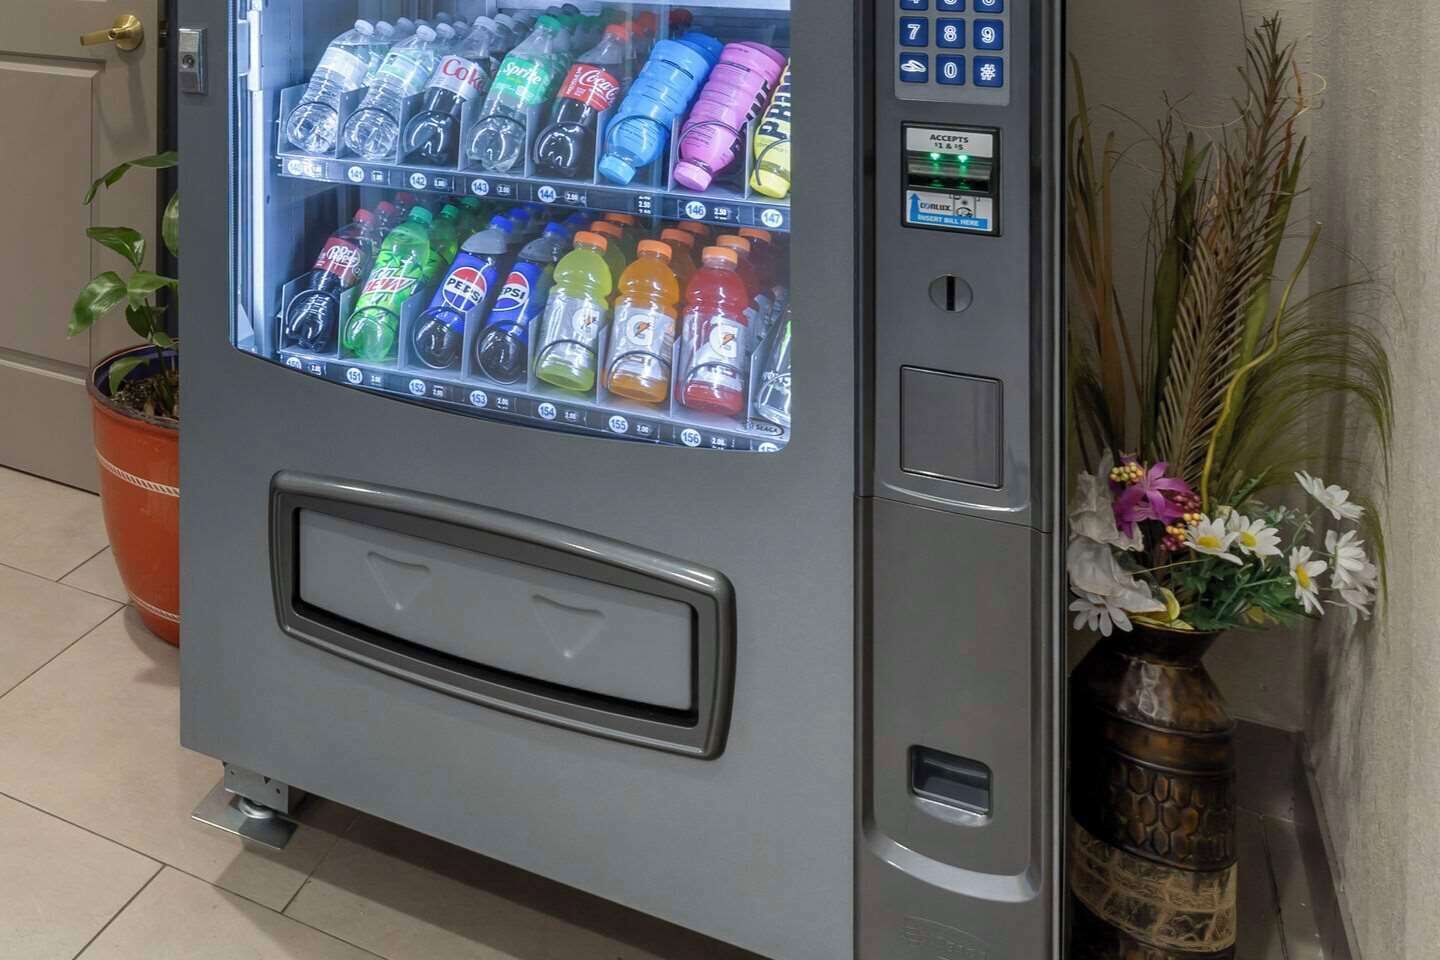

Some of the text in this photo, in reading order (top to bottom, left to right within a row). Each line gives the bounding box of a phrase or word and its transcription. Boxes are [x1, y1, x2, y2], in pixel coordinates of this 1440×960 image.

[907, 23, 995, 44] 7 8 9
[503, 61, 542, 86] Sprite
[944, 62, 996, 81] 0 #
[929, 134, 969, 143] ACCEPTS
[472, 181, 488, 192] 143
[539, 188, 556, 200] 144
[687, 204, 705, 217] 146
[762, 212, 782, 225] 147
[447, 277, 483, 303] PEPSI
[501, 286, 525, 300] EPSI
[409, 381, 426, 393] 152
[470, 392, 487, 404] 153
[539, 405, 556, 417] 154
[610, 418, 628, 431] 155
[682, 431, 700, 444] 156
